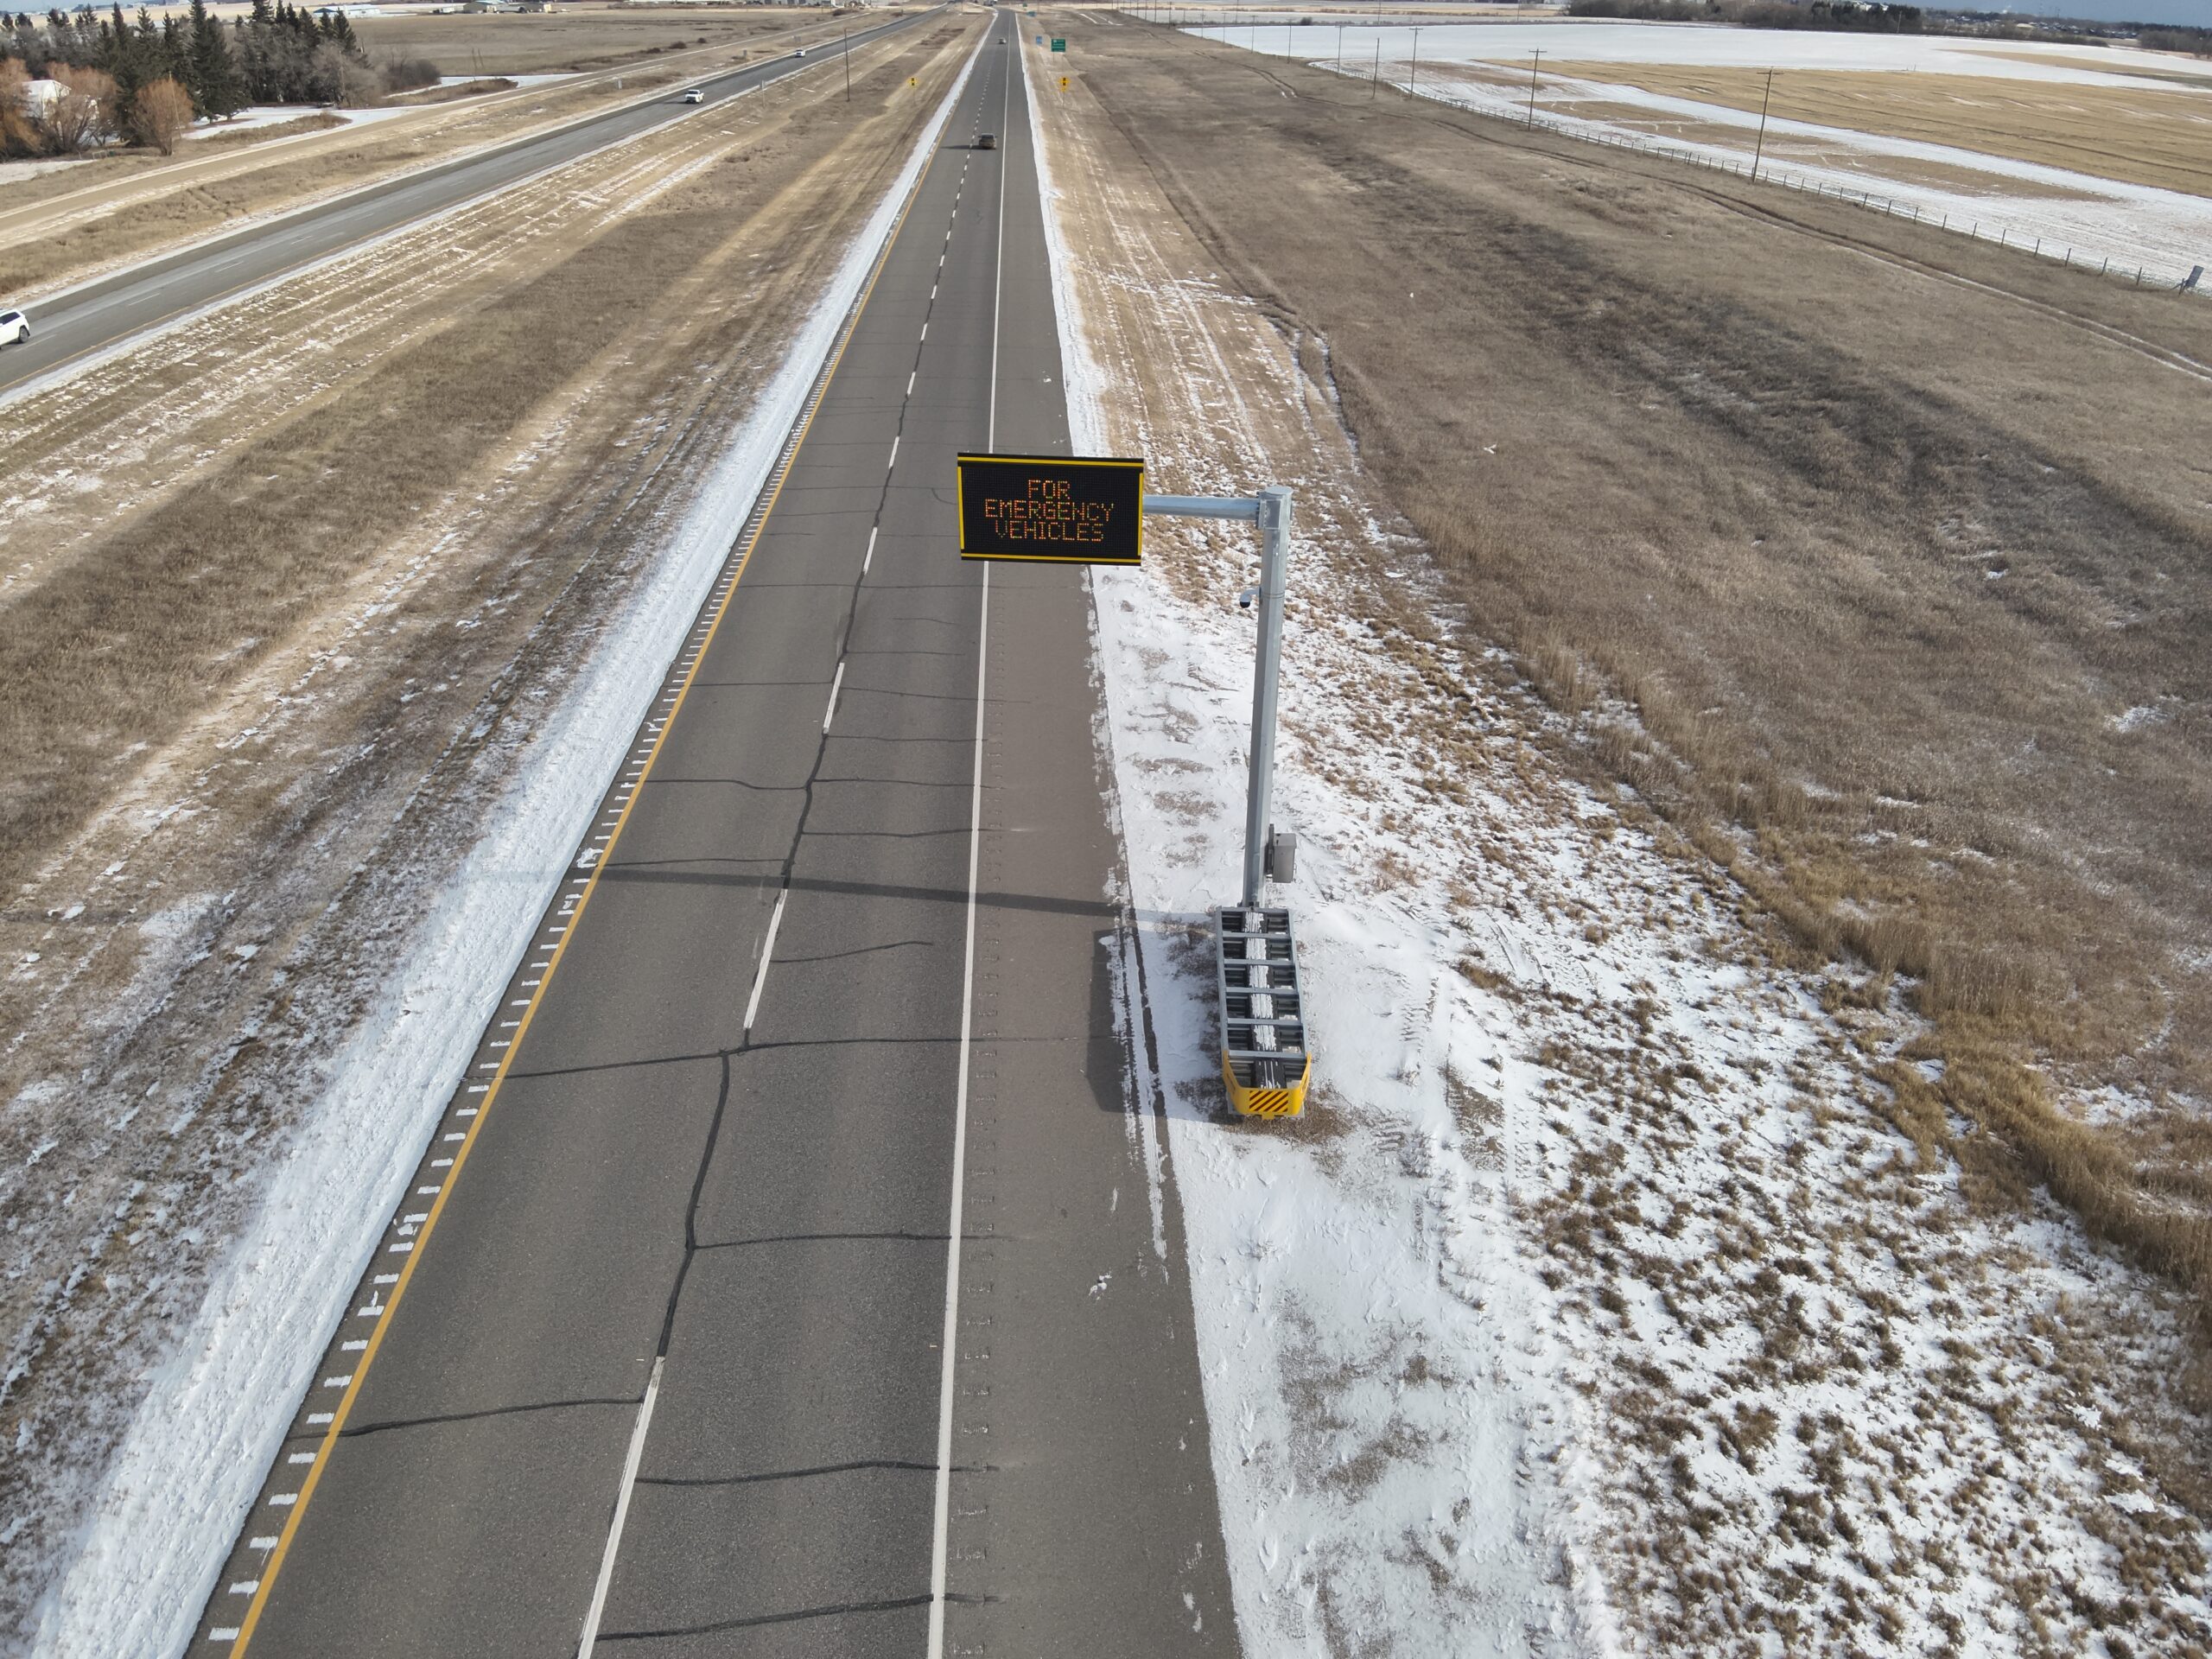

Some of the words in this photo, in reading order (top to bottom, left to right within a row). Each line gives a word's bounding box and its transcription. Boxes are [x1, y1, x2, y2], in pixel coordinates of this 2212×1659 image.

[1027, 479, 1071, 499] FOR
[984, 499, 1115, 522] EMERGENCY
[995, 519, 1104, 542] VEHICLES
